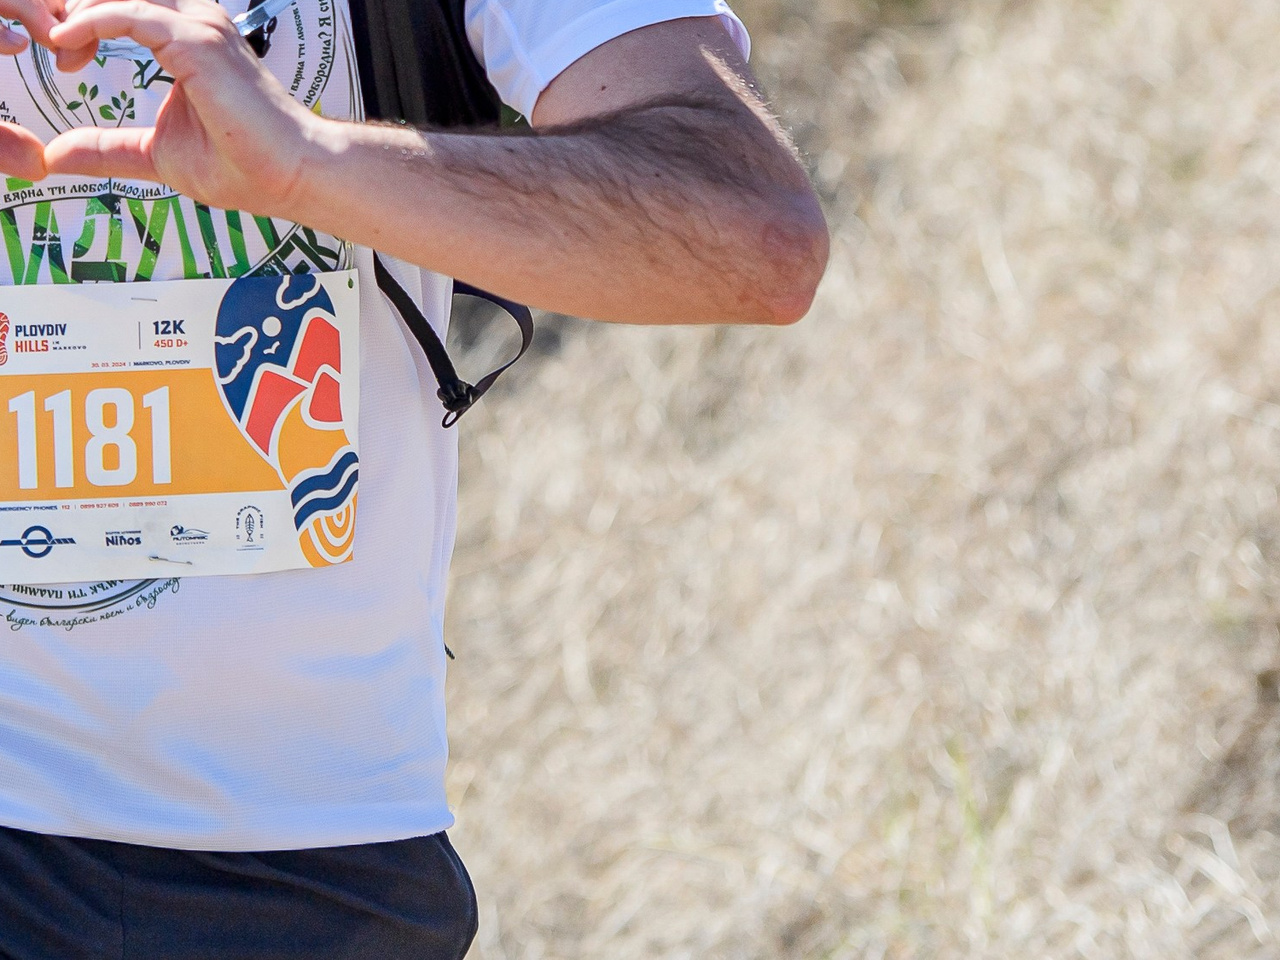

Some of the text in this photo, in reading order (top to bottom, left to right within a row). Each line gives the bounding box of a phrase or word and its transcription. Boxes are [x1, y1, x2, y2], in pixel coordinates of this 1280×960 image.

[15, 323, 68, 338] PLOVDIV
[153, 319, 186, 336] 12K
[15, 340, 49, 353] HILLS
[153, 338, 189, 348] 450 D+
[8, 386, 172, 490] 1181
